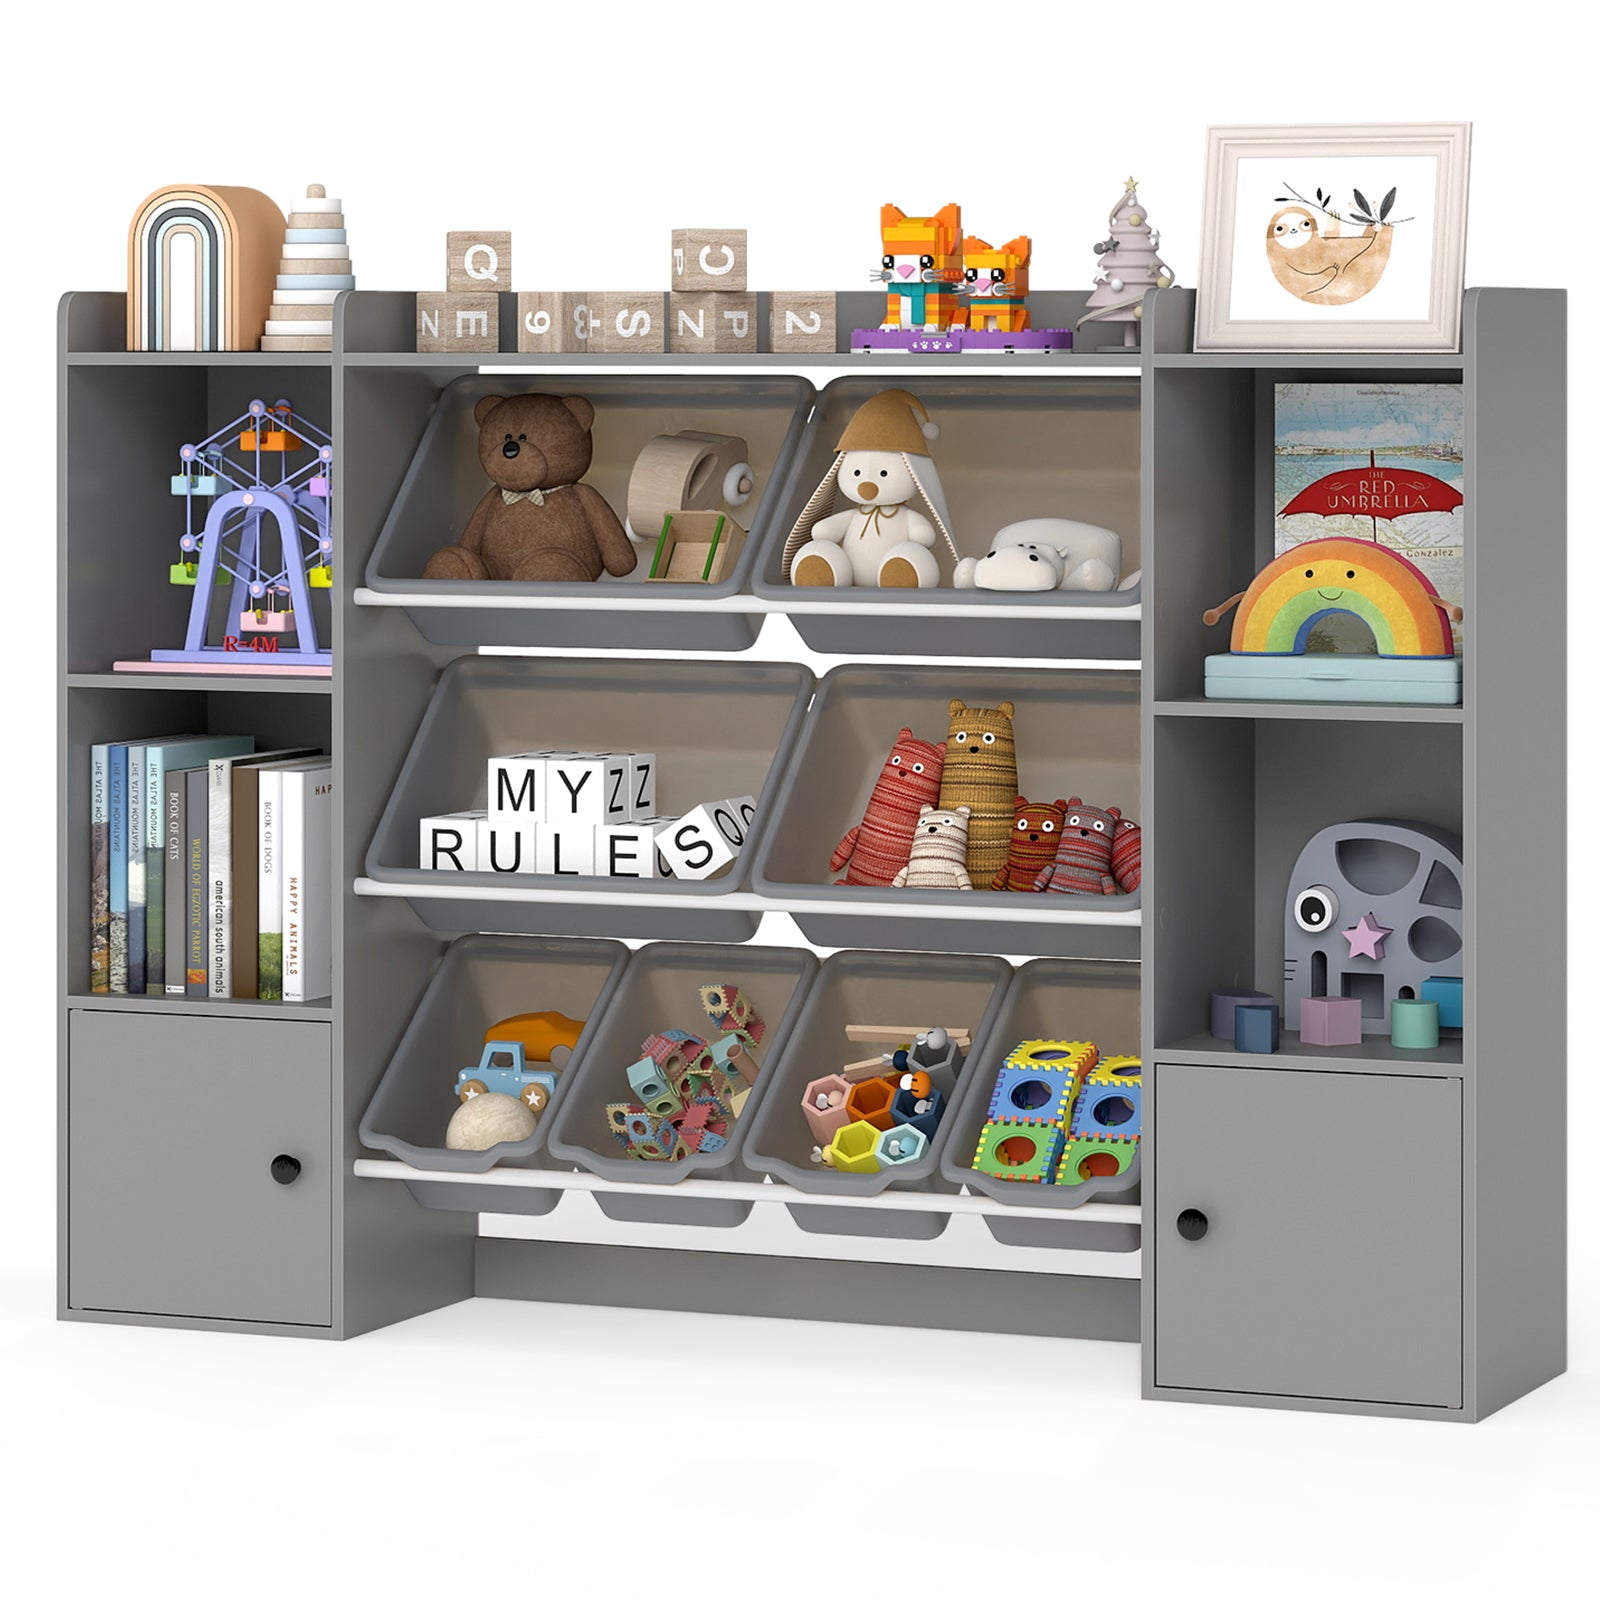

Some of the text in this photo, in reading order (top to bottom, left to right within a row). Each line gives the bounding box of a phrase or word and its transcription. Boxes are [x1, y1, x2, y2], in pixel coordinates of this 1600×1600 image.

[464, 244, 498, 282] Q
[699, 244, 735, 276] C
[456, 310, 488, 338] E
[615, 309, 651, 338] S
[723, 310, 749, 339] P
[785, 310, 822, 335] 2
[1359, 480, 1396, 495] RED
[1368, 471, 1385, 479] THE
[1327, 494, 1429, 511] UMBRELLA
[497, 768, 592, 813] MY
[169, 792, 179, 860] BOOK OF CATS
[264, 801, 272, 874] BOOK OF DOGS
[192, 838, 201, 871] WORLD
[192, 873, 201, 885] OF
[215, 879, 226, 994] american south animals
[289, 877, 298, 975] HAPPY ANIMALS
[191, 929, 201, 964] PARROT
